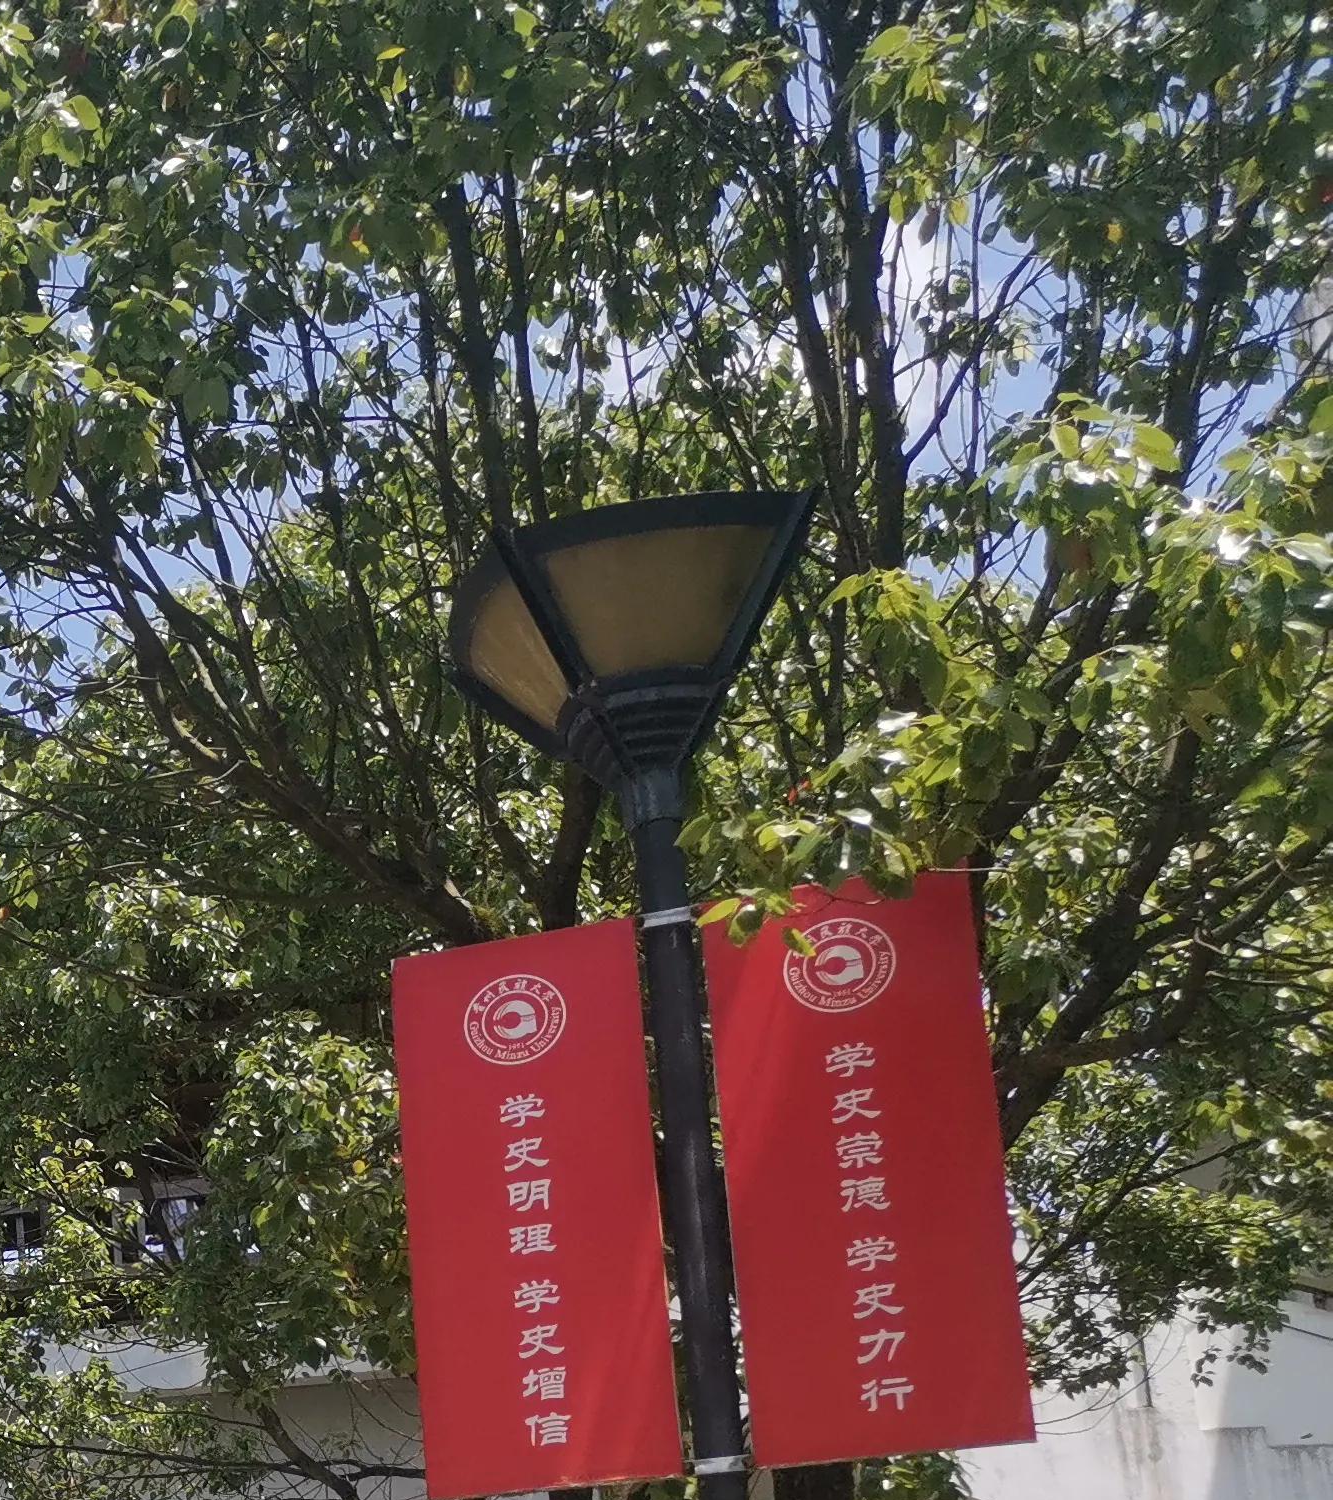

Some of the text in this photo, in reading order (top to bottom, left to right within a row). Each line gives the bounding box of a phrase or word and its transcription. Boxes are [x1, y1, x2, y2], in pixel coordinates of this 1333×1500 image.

[793, 922, 883, 959] 民族大学
[789, 966, 818, 1003] Guizhou
[469, 1006, 562, 1060] Guizhou Minzu University
[825, 1041, 915, 1413] 学史崇德 学史力行
[499, 1093, 572, 1447] 学史明理 学史增信
